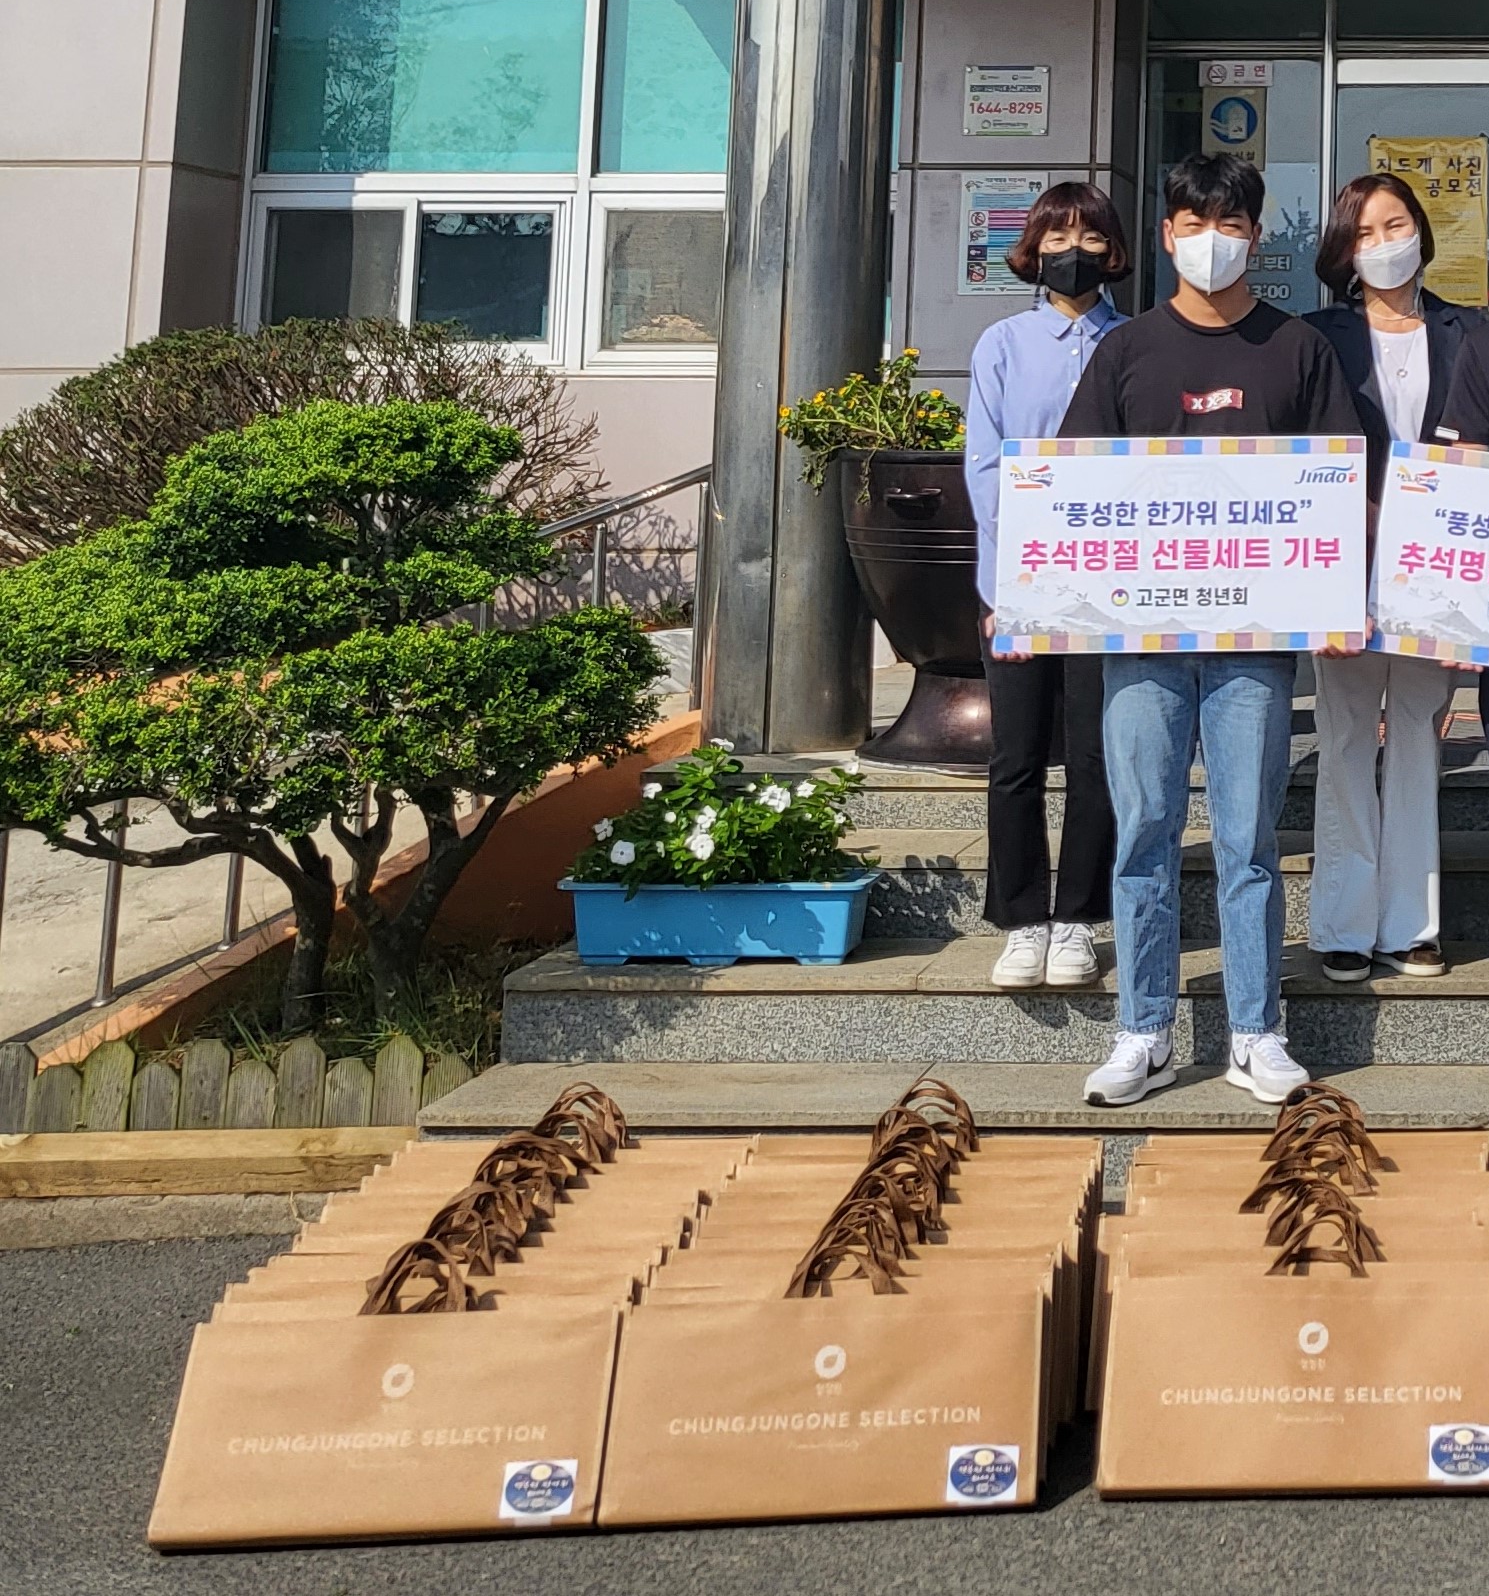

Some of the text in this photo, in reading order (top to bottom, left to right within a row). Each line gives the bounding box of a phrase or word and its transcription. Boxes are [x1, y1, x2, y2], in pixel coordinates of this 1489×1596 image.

[969, 102, 1043, 114] 1644-8295
[1446, 155, 1482, 177] 사진
[1425, 177, 1483, 198] 공모전
[1263, 256, 1291, 271] 부터
[1245, 284, 1290, 299] 3:00
[1294, 467, 1347, 485] Jindo
[1052, 499, 1312, 528] “풍성한 한가위 되세요”
[1021, 537, 1341, 573] 추석명절 선물세트 기부
[1135, 586, 1248, 607] 고군면 청년회
[1159, 1385, 1462, 1406] CHUNGJUNGONE SELECTION
[667, 1406, 981, 1437] CHUNGJUNGONE SELECTION
[227, 1425, 547, 1456] CHUNGJUNGONE SELECTION
